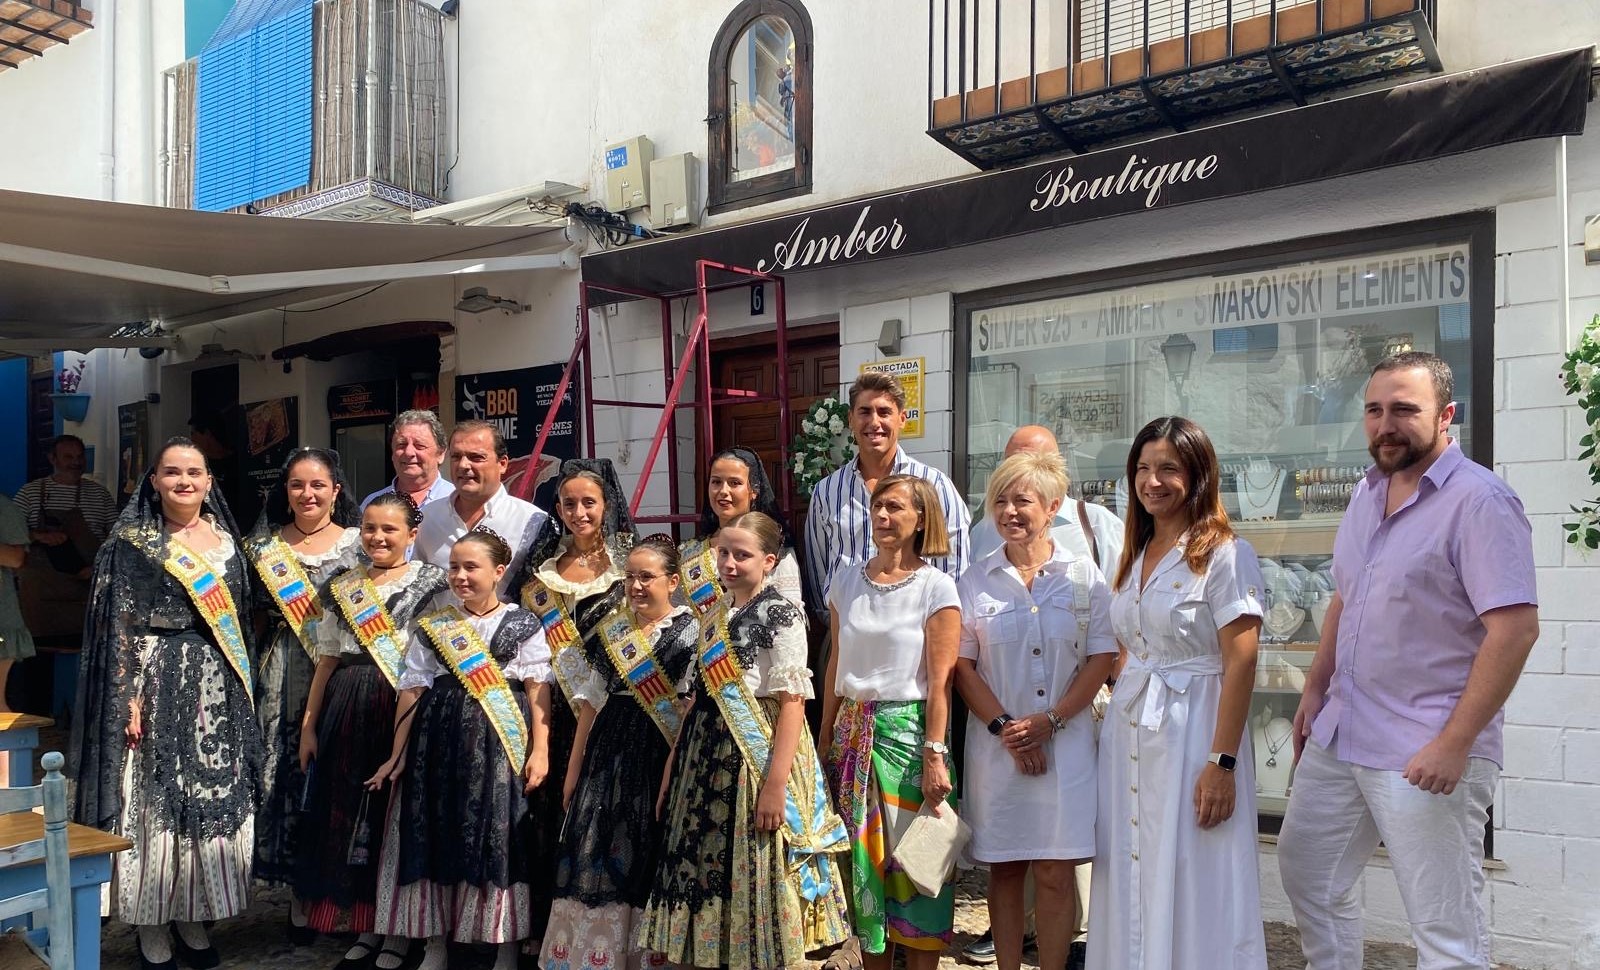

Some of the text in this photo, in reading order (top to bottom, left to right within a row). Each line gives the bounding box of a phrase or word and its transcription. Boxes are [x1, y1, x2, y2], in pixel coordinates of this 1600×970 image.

[757, 153, 1219, 274] Amber Boutique
[753, 286, 762, 311] 6
[978, 306, 1037, 351] SILVER
[1042, 302, 1073, 344] 925
[1096, 293, 1166, 338] AMBER
[1194, 269, 1323, 326] SWAROVSKI
[1336, 251, 1465, 311] ELEMENTS
[535, 382, 573, 393] ENTRET
[486, 387, 518, 416] BBQ
[535, 421, 573, 432] CRNES
